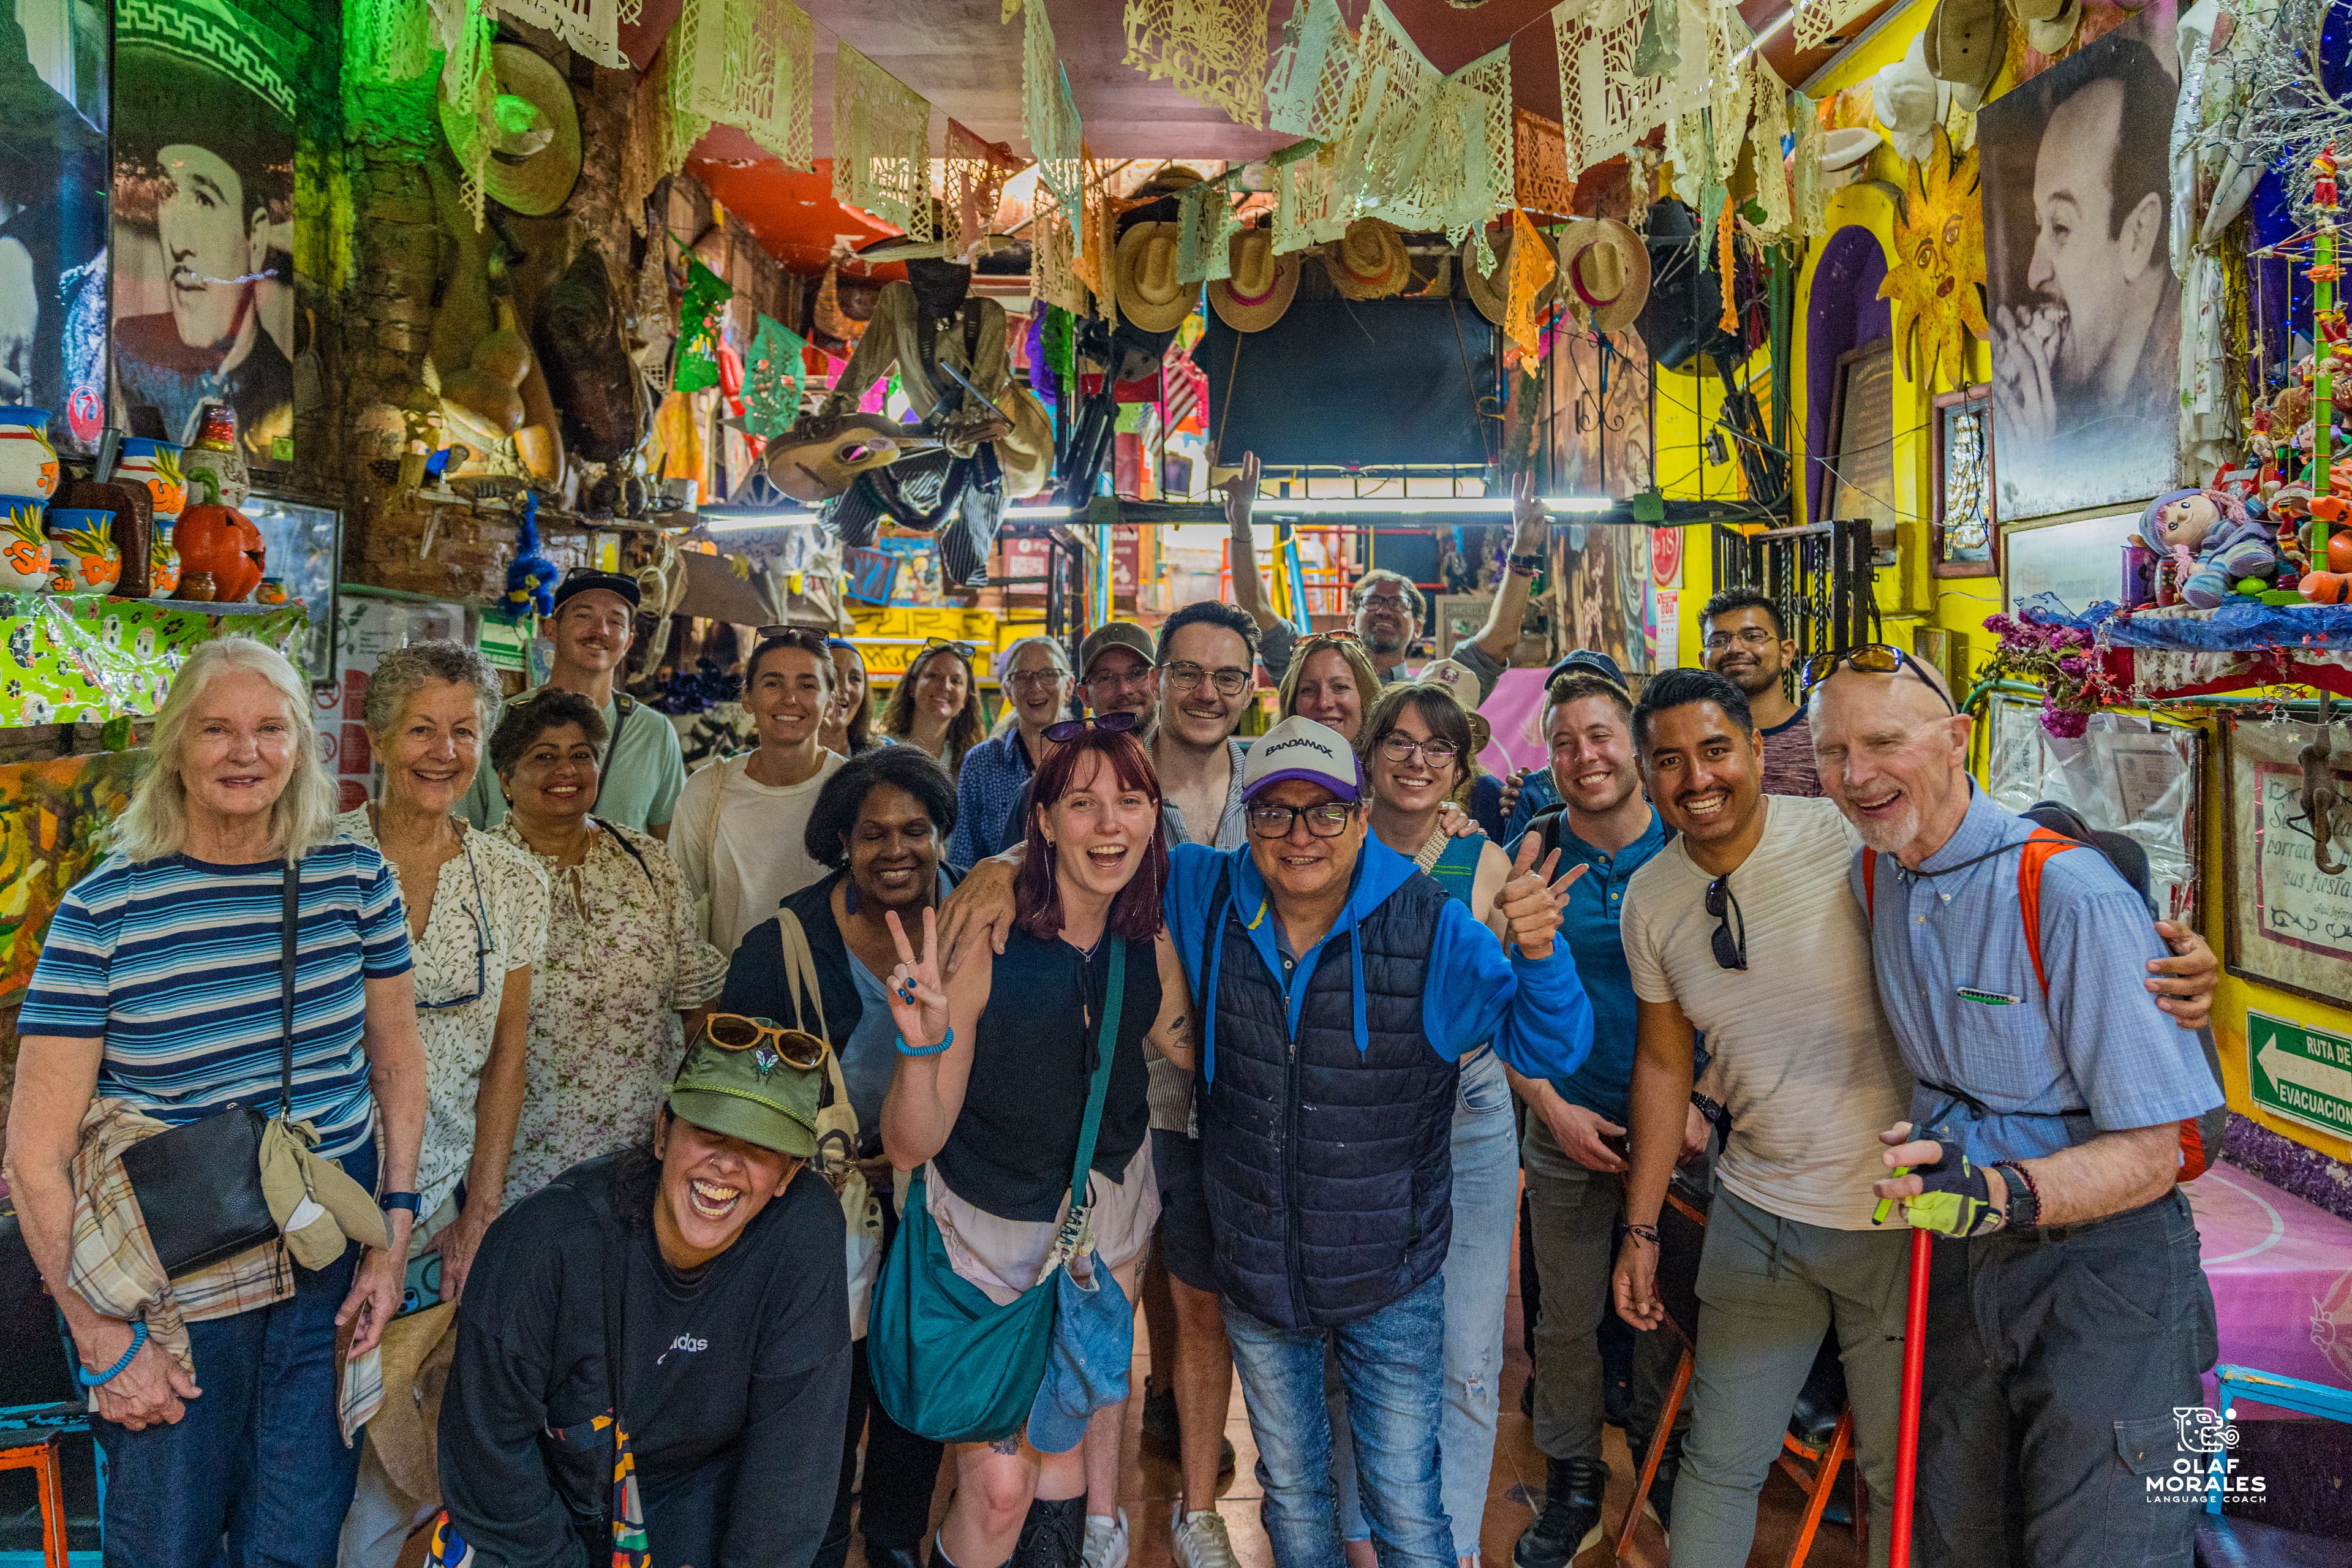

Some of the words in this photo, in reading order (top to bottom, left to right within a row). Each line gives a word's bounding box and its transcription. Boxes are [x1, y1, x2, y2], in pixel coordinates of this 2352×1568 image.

[1265, 738, 1333, 759] BANDAMAX
[2267, 835, 2332, 862] borrac
[2283, 870, 2306, 888] sus
[2306, 872, 2352, 897] fiesta
[2306, 1036, 2334, 1061] RUTA
[2336, 1044, 2351, 1066] DE
[2280, 1084, 2352, 1125] EVACUACION
[657, 1333, 707, 1365] idas
